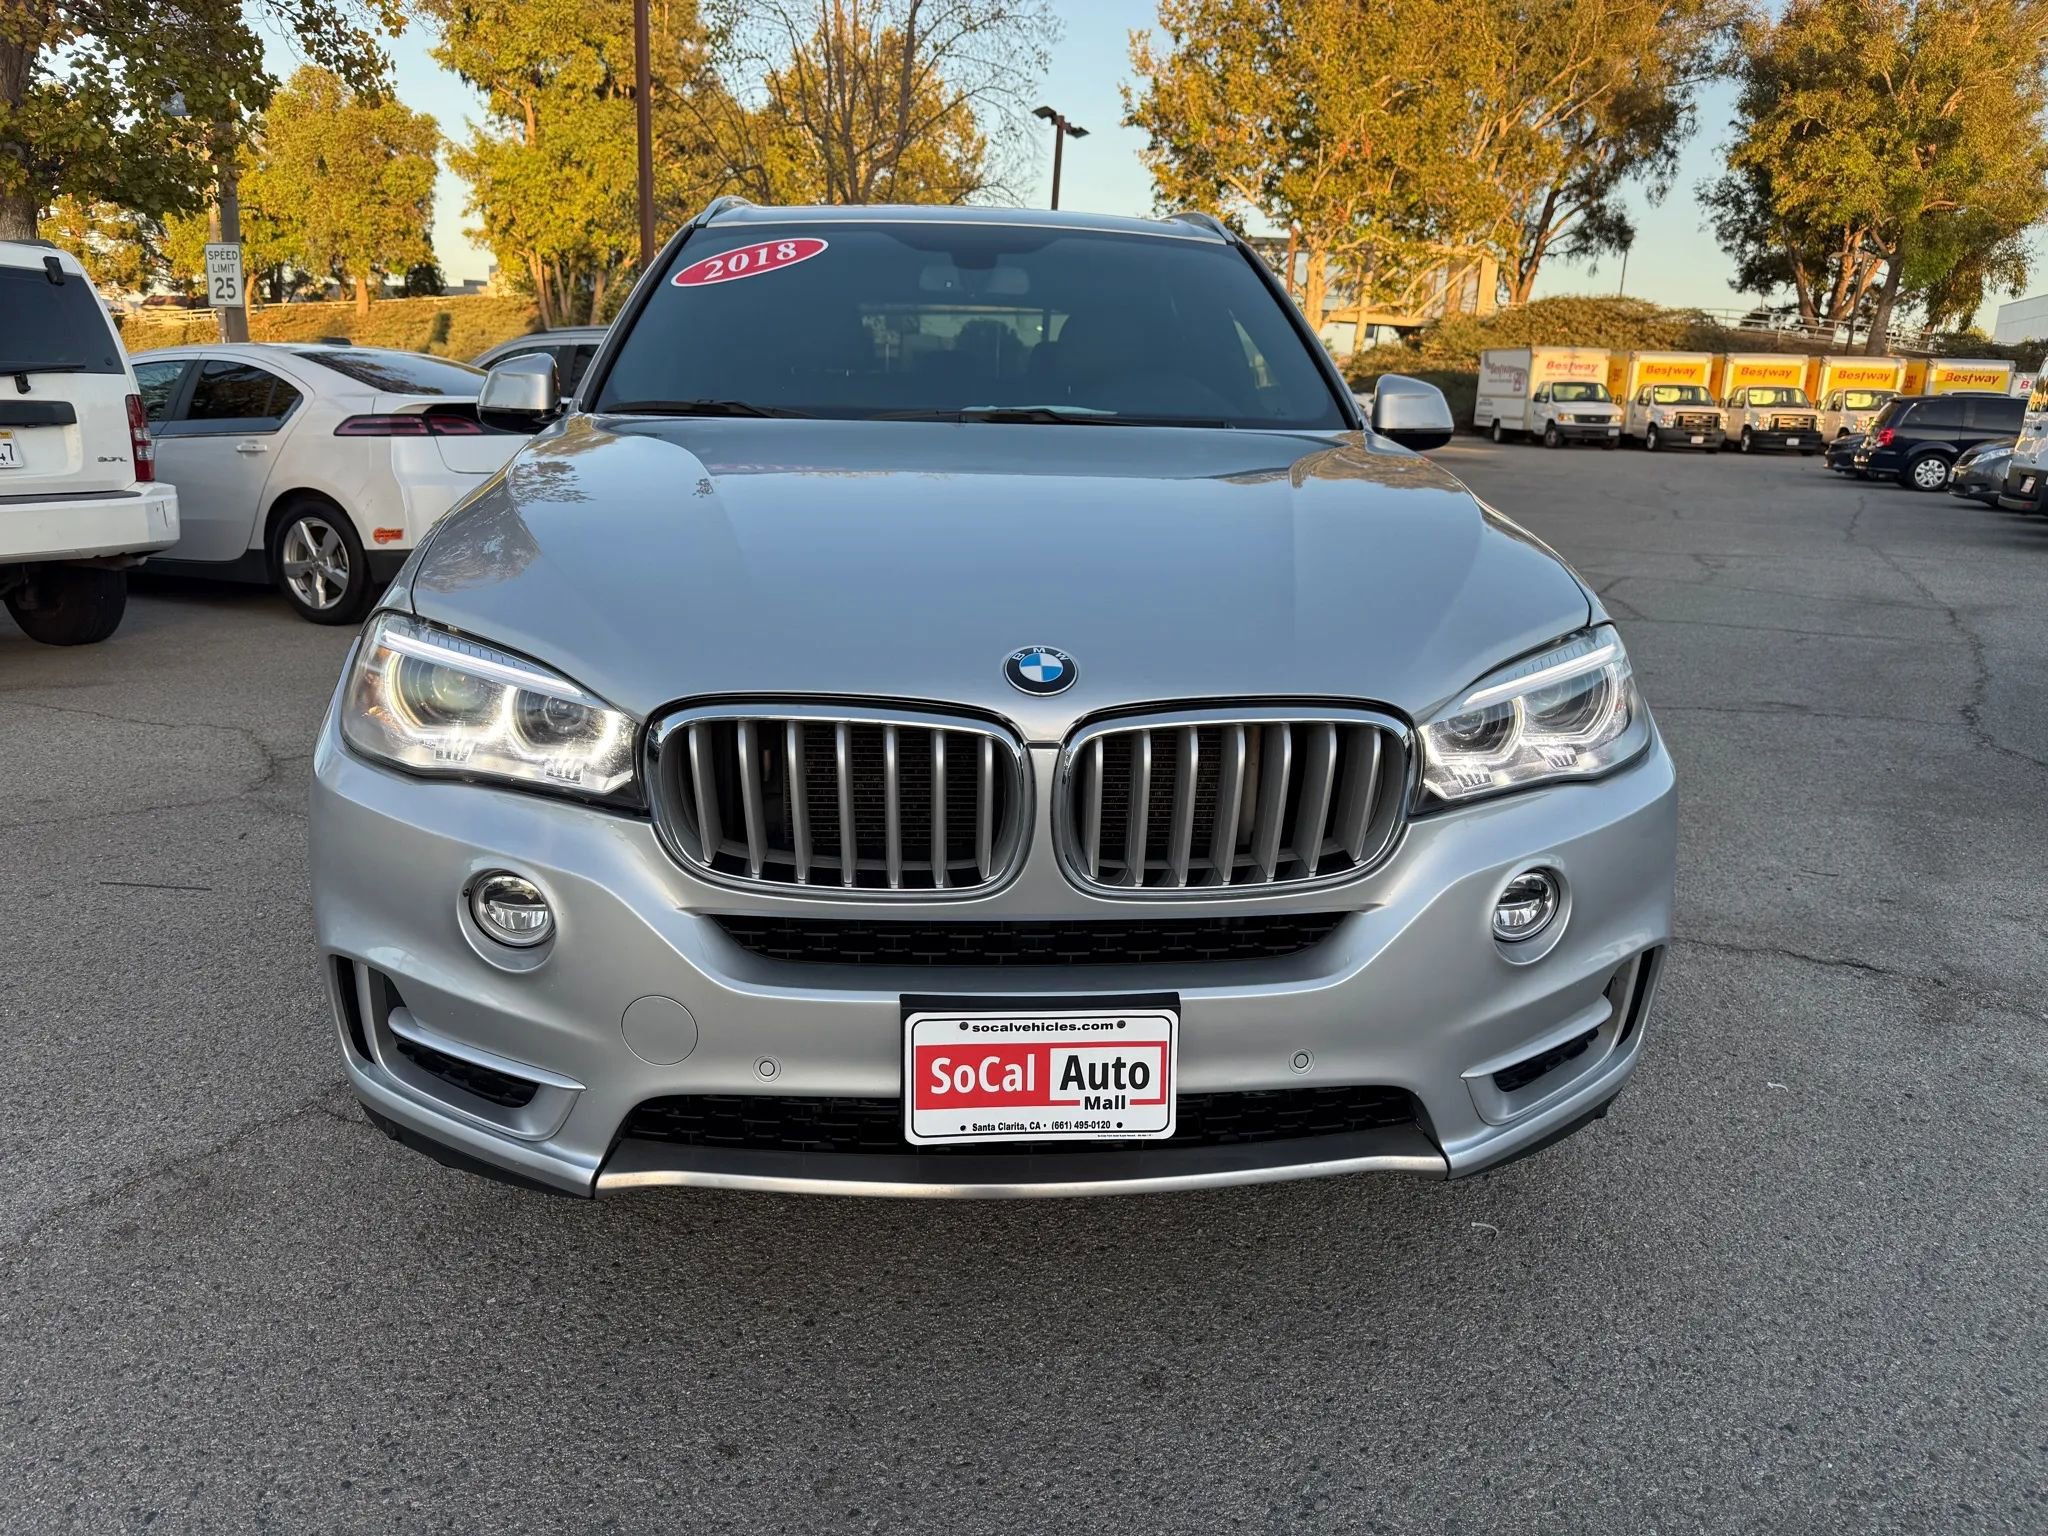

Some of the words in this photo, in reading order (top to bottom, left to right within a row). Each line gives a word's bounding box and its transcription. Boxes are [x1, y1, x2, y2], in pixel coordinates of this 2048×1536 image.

[207, 250, 238, 260] SPEED
[703, 241, 797, 280] 2018
[212, 263, 235, 273] LIMIT
[214, 277, 236, 299] 25
[1545, 360, 1599, 373] Bestway
[1645, 365, 1697, 378] Bestway
[1740, 367, 1792, 379] Bestway
[1837, 370, 1891, 382] Bestway
[1944, 372, 2000, 385] Bestway
[1011, 647, 1069, 661] BMW
[972, 1021, 1114, 1033] socalvehicles.com
[930, 1053, 1036, 1095] SoCal
[1059, 1054, 1150, 1091] Auto
[1084, 1095, 1126, 1111] Mall
[972, 1122, 996, 1132] Santa
[998, 1121, 1027, 1132] Clarita,
[1029, 1121, 1041, 1131] CA
[1051, 1120, 1072, 1131] (661)
[1074, 1120, 1111, 1130] 495-0120
